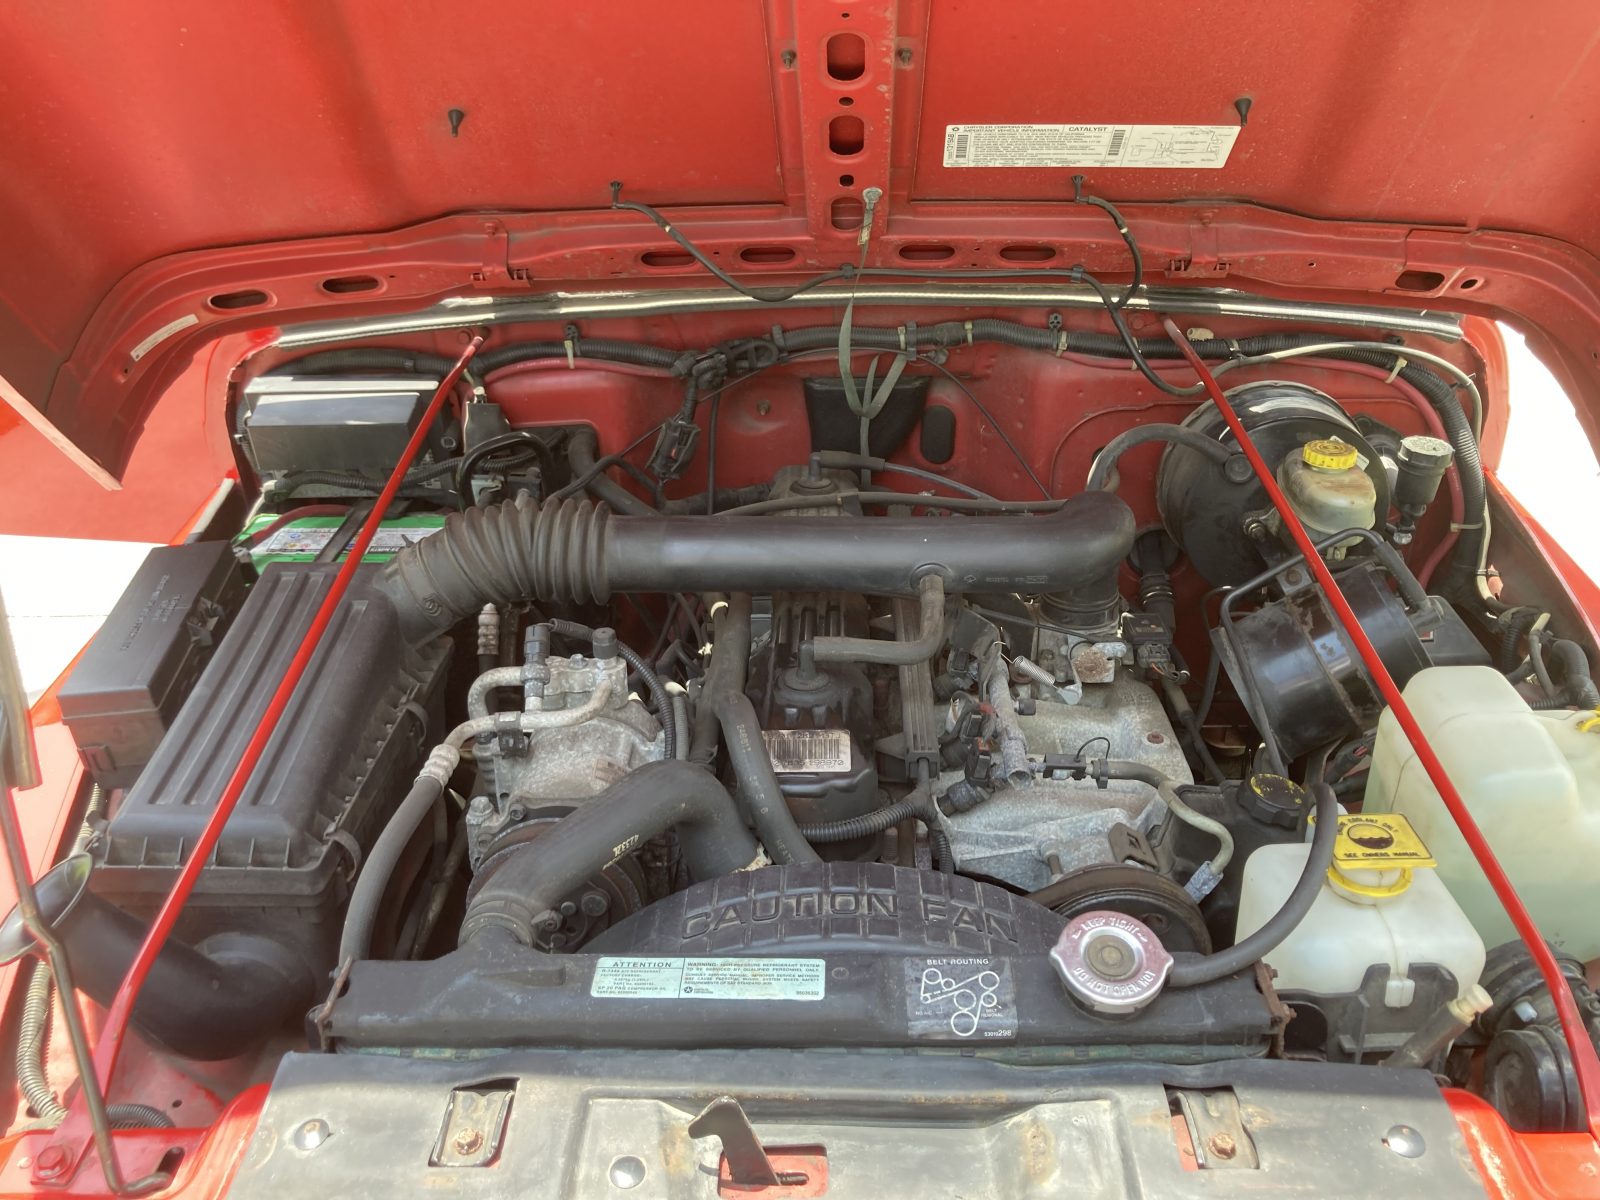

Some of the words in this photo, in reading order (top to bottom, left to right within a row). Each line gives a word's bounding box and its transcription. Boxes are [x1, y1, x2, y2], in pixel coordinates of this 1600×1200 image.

[681, 892, 899, 940] CAUTION
[921, 900, 1018, 943] FAN
[1080, 917, 1106, 931] KEEP
[1108, 917, 1140, 934] TIGHT
[926, 958, 946, 966] BELT
[1072, 967, 1089, 982] DO
[1087, 979, 1110, 994] NOT
[1112, 983, 1141, 996] OPEN
